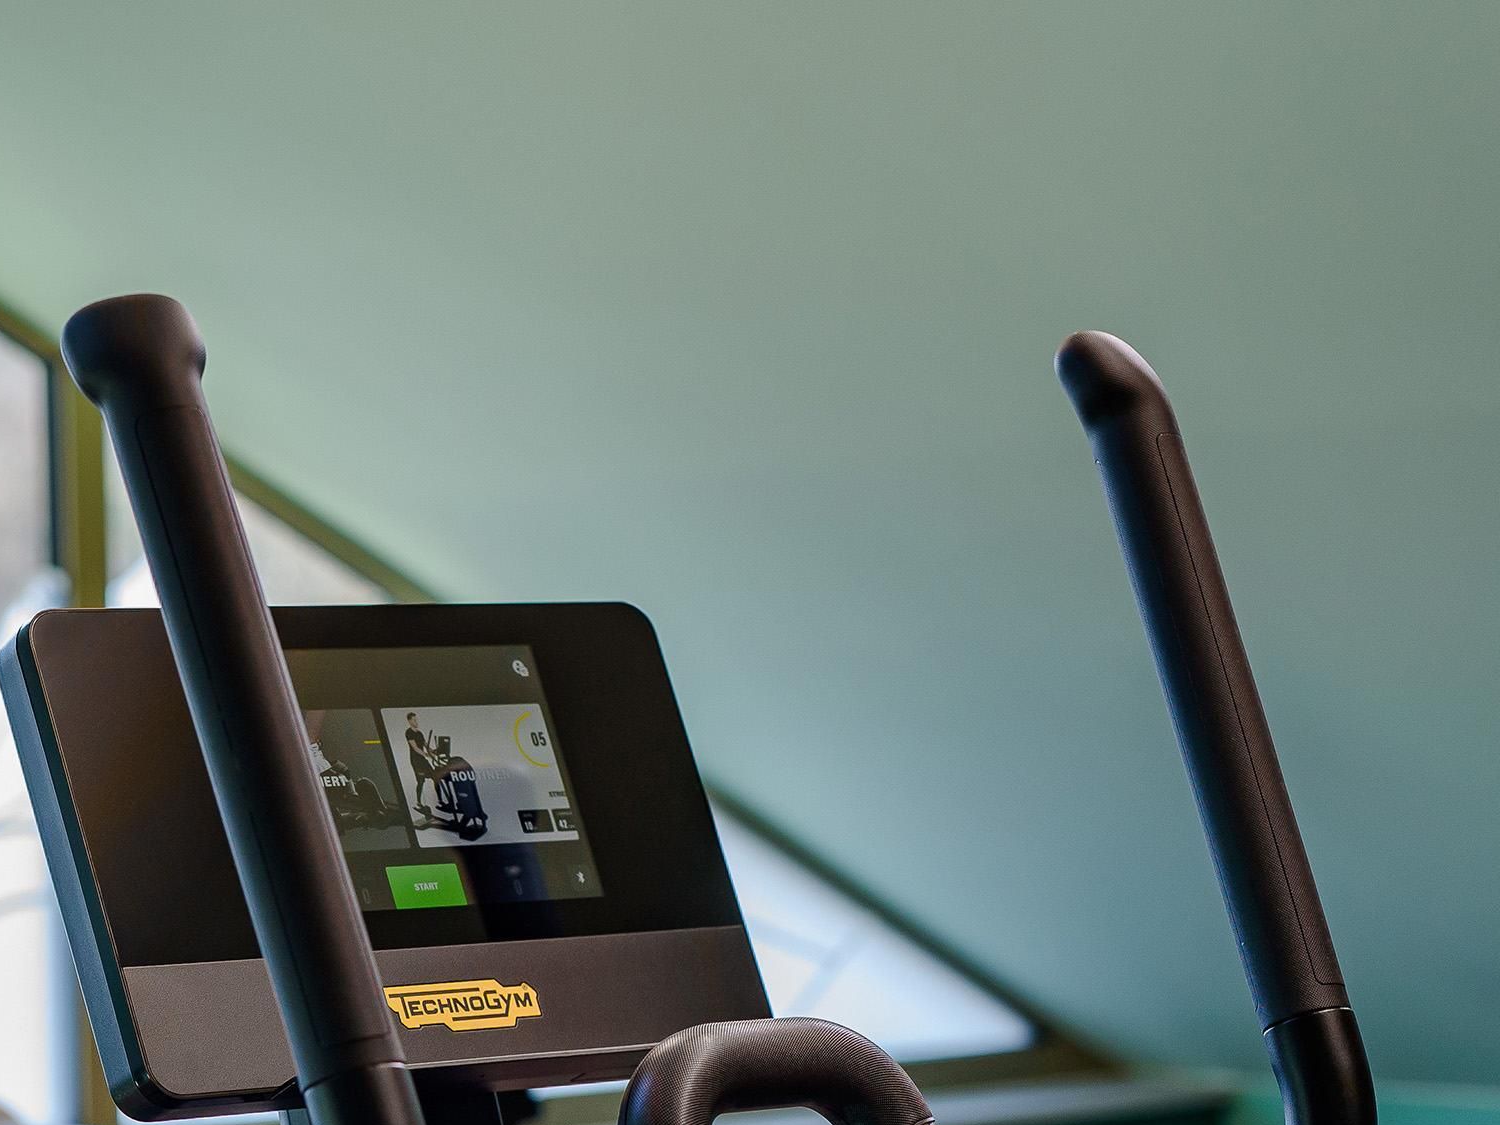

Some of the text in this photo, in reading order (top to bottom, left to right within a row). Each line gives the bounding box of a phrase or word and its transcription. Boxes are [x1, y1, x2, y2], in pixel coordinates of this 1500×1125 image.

[530, 732, 547, 746] 05
[414, 882, 438, 892] START
[388, 987, 533, 1022] TECHNOGYM
